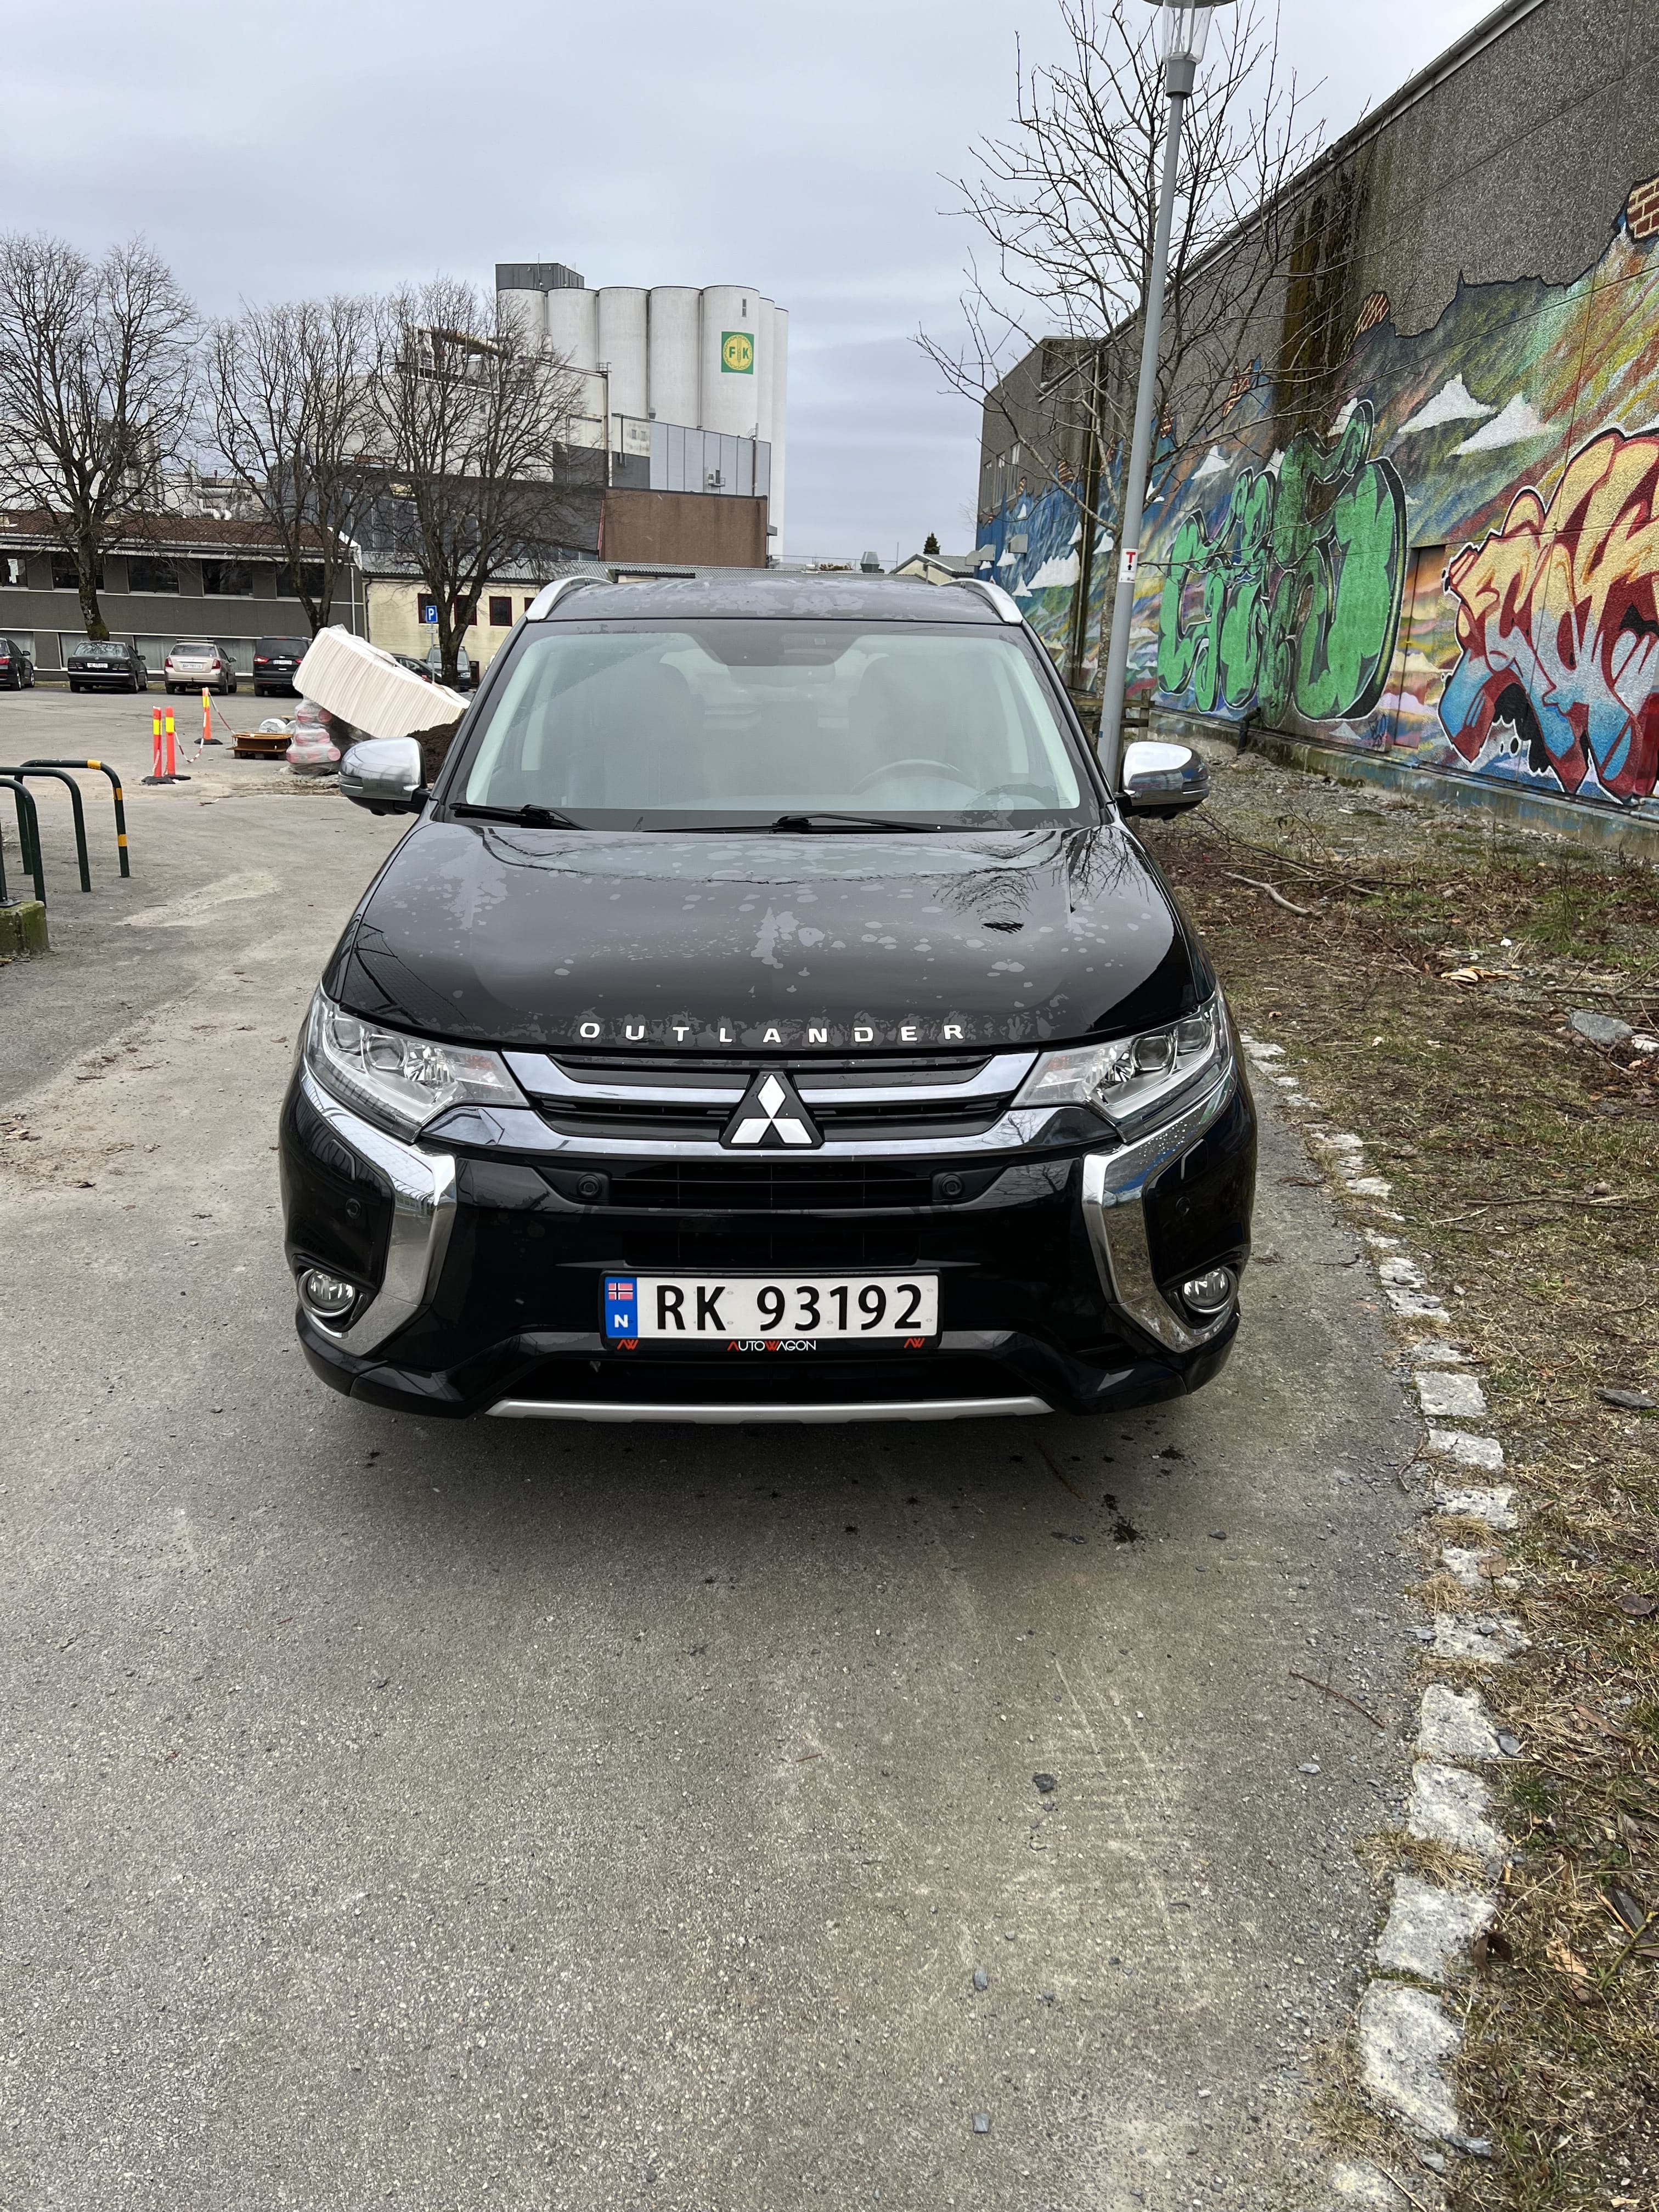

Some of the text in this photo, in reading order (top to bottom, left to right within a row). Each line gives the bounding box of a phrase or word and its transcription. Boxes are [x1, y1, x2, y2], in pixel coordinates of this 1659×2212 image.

[1126, 551, 1136, 563] T
[428, 608, 435, 620] P
[579, 1022, 964, 1043] OUTLANDER
[657, 1284, 922, 1331] RK 93192
[614, 1314, 628, 1328] N
[727, 1340, 816, 1351] AUTOWAGON
